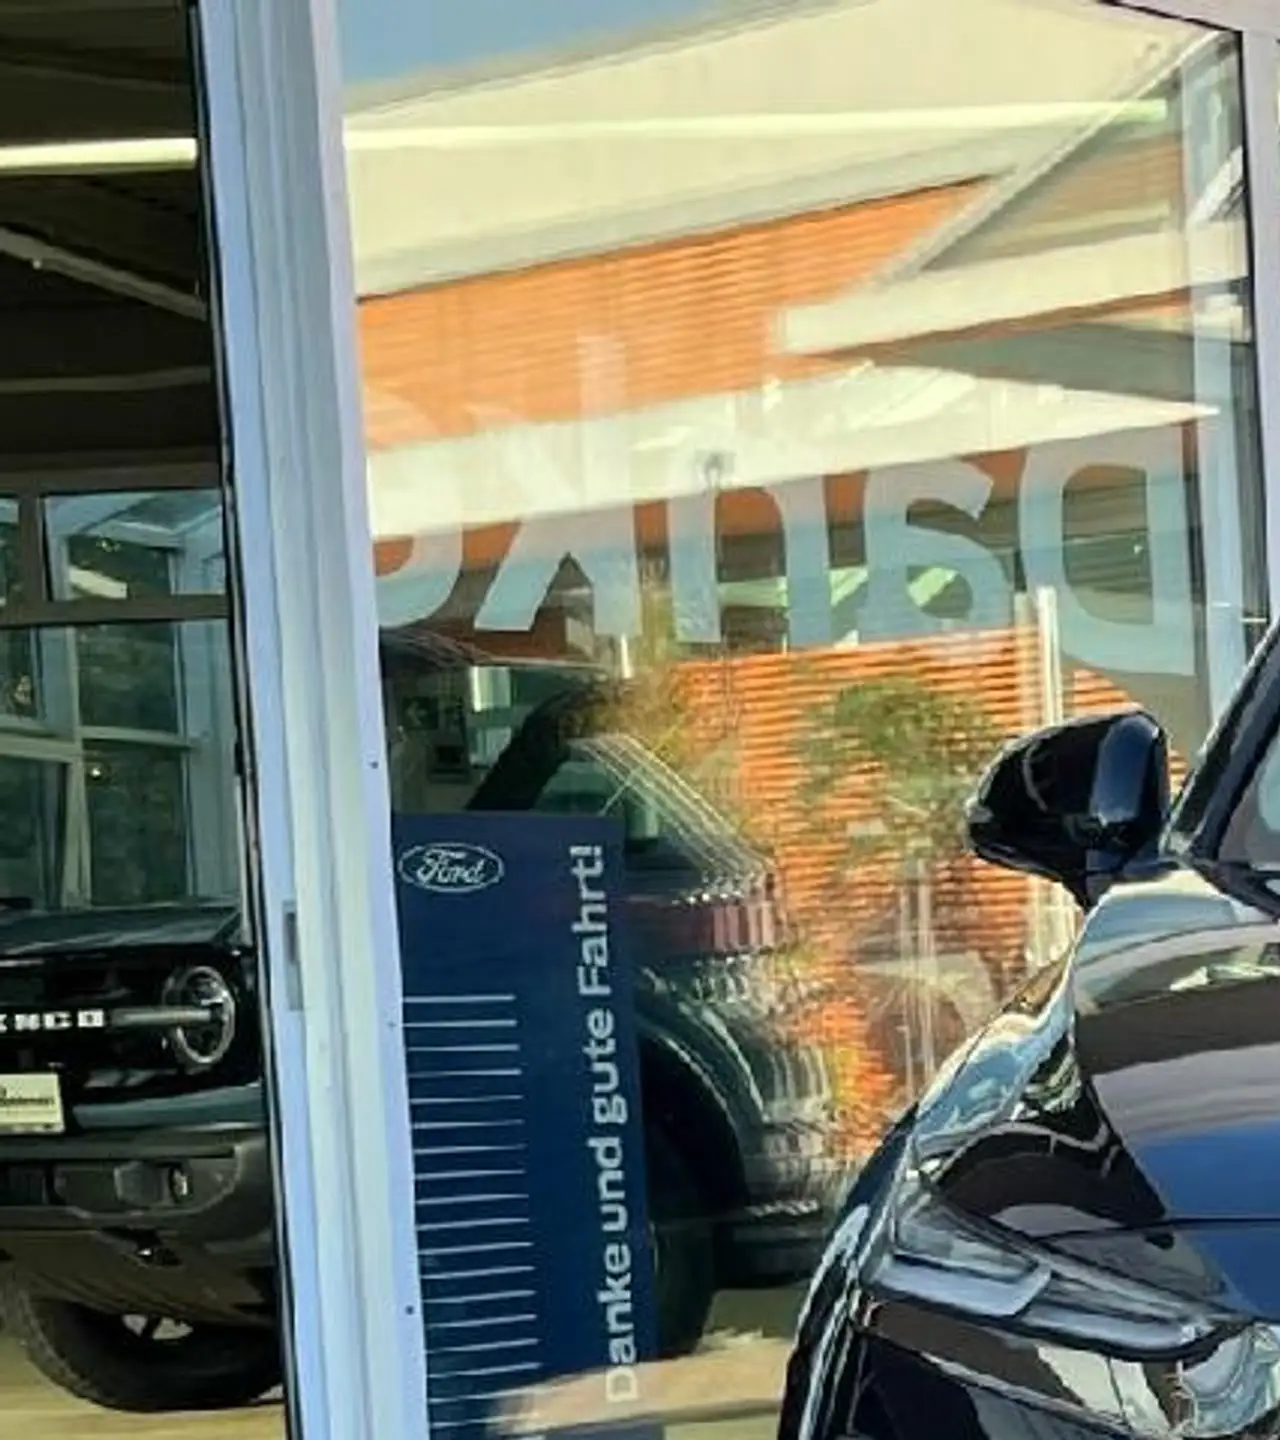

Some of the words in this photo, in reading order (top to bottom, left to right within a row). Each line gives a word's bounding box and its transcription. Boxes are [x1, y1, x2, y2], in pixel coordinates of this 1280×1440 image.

[569, 845, 612, 995] Fahrt!
[582, 1008, 628, 1124] gute
[588, 1136, 629, 1232] und
[597, 1243, 640, 1401] Danke
